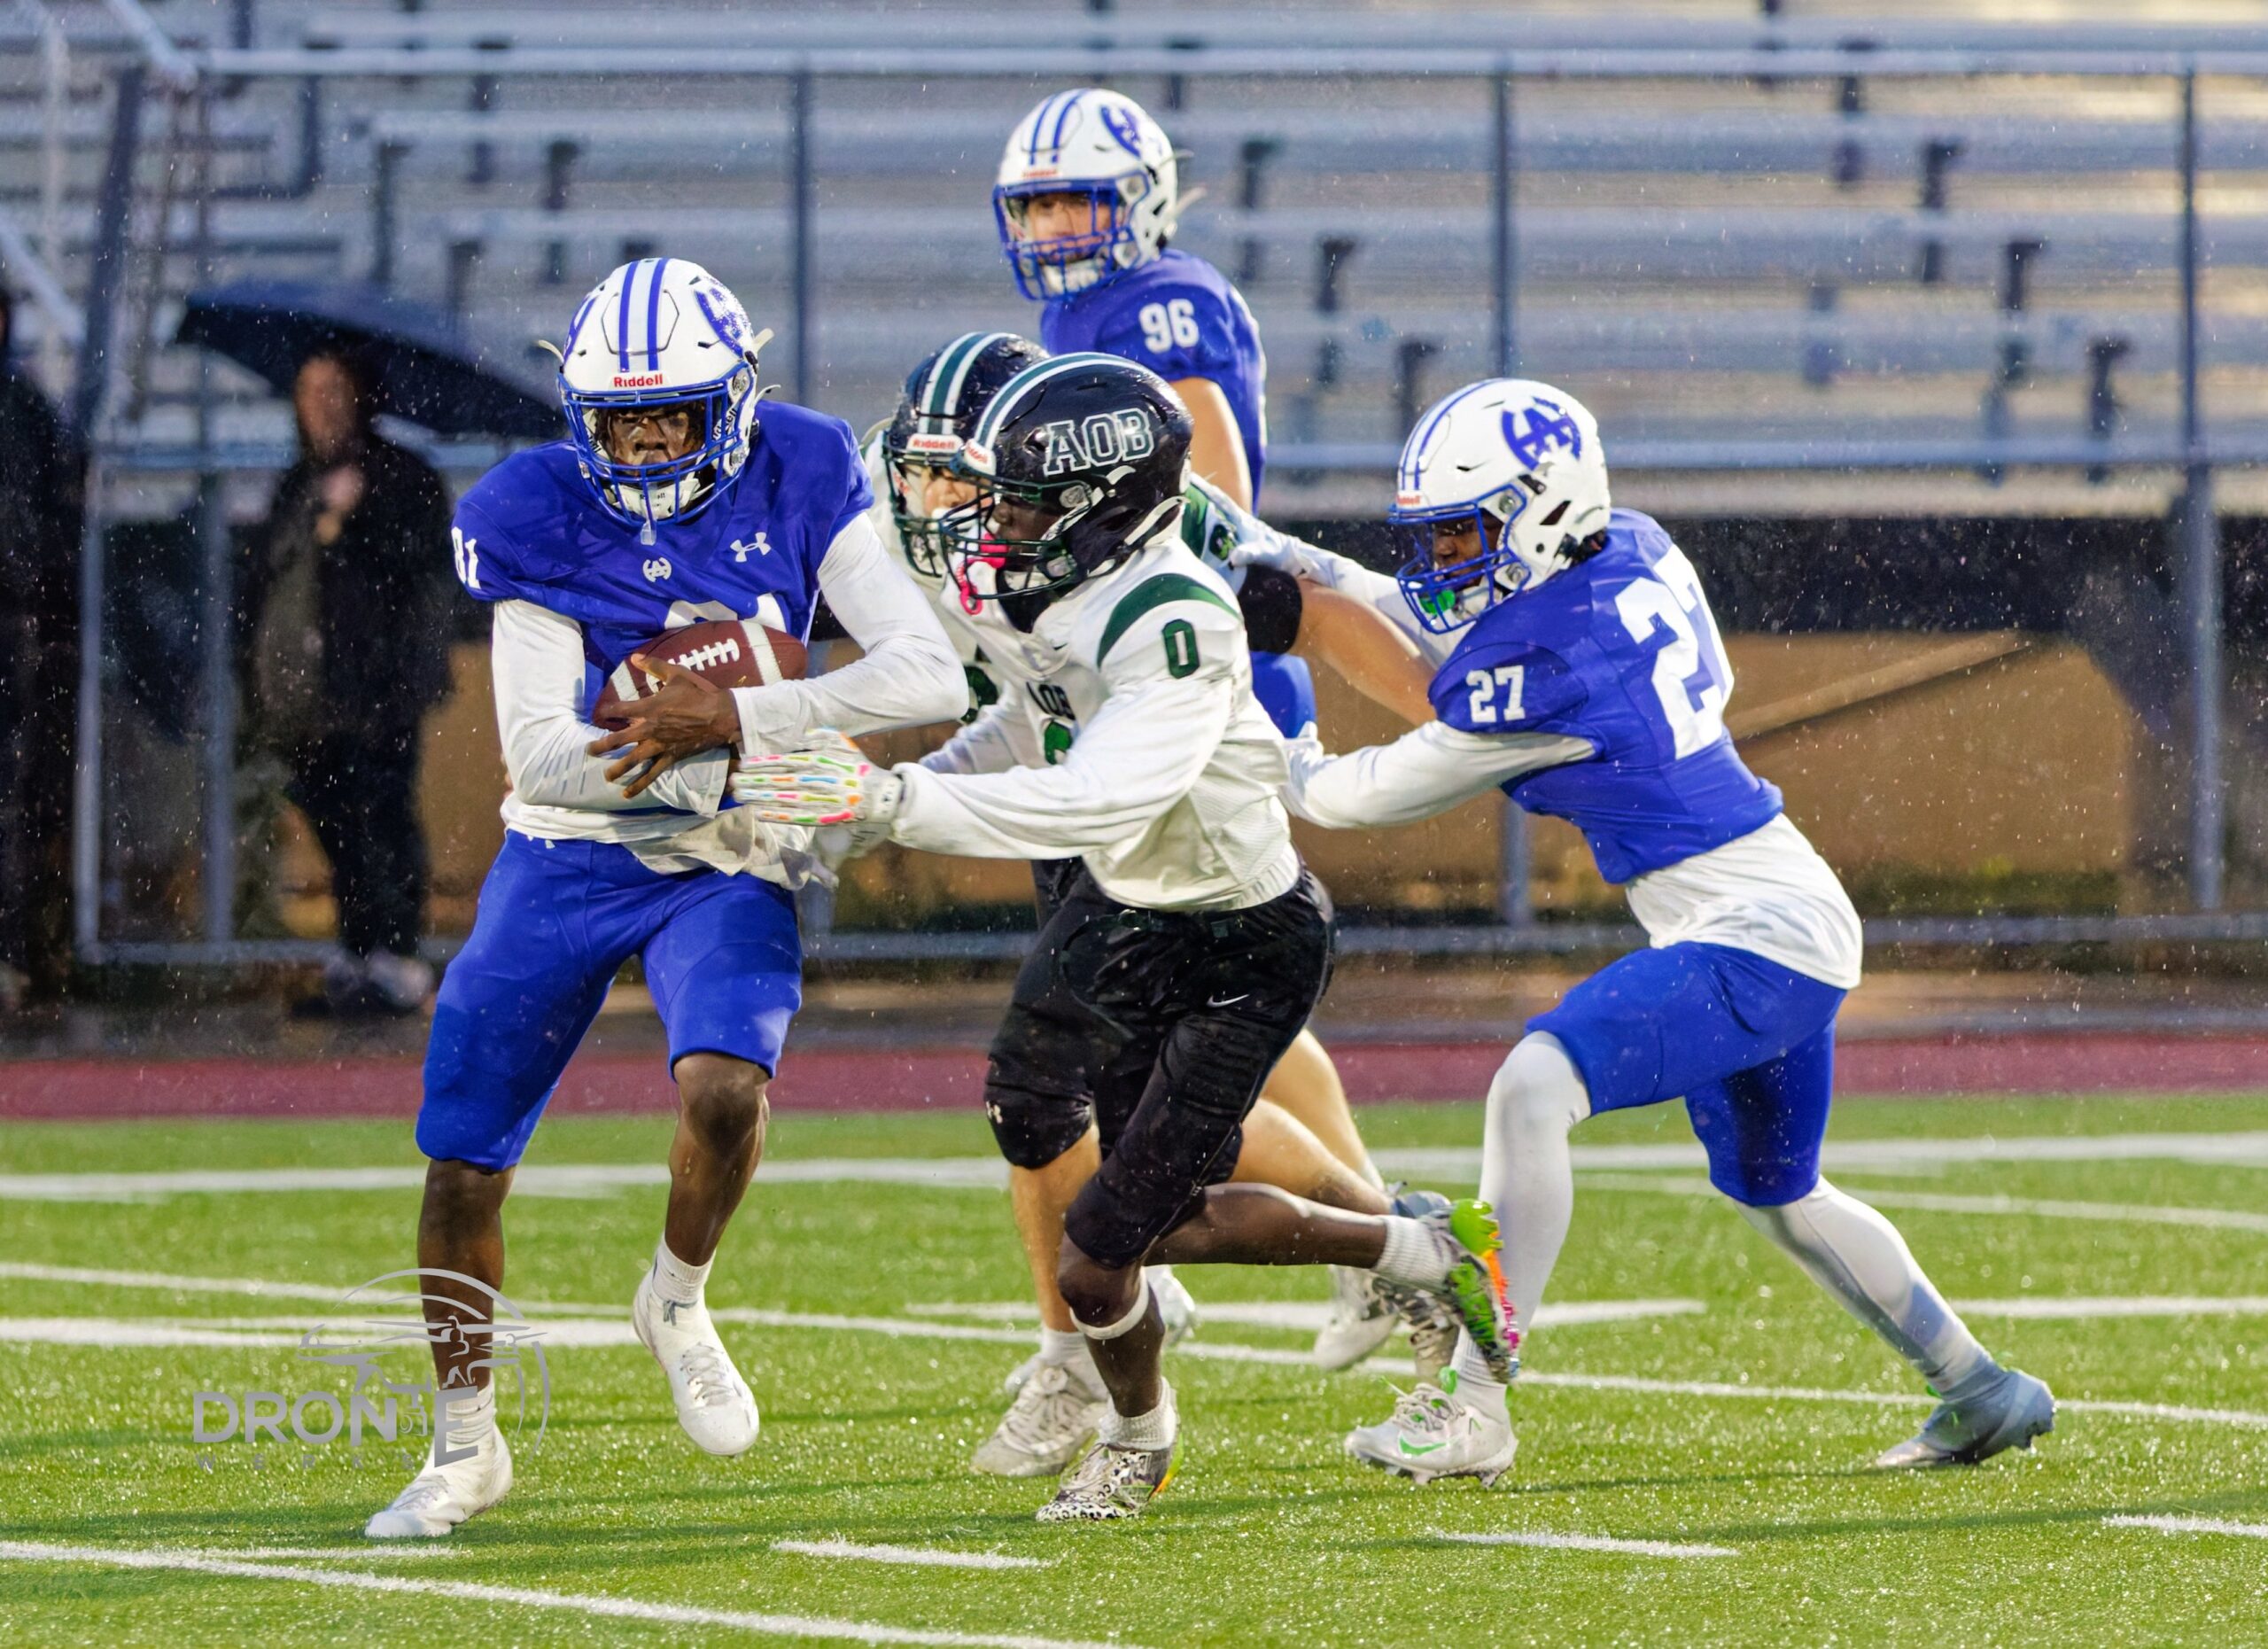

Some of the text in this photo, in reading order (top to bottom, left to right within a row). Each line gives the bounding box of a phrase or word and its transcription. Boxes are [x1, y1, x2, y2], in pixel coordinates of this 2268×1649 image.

[1139, 298, 1200, 354] 96
[614, 374, 664, 388] Riddell
[1043, 408, 1154, 476] AOB
[451, 526, 481, 590] 81
[1466, 665, 1526, 724] 27
